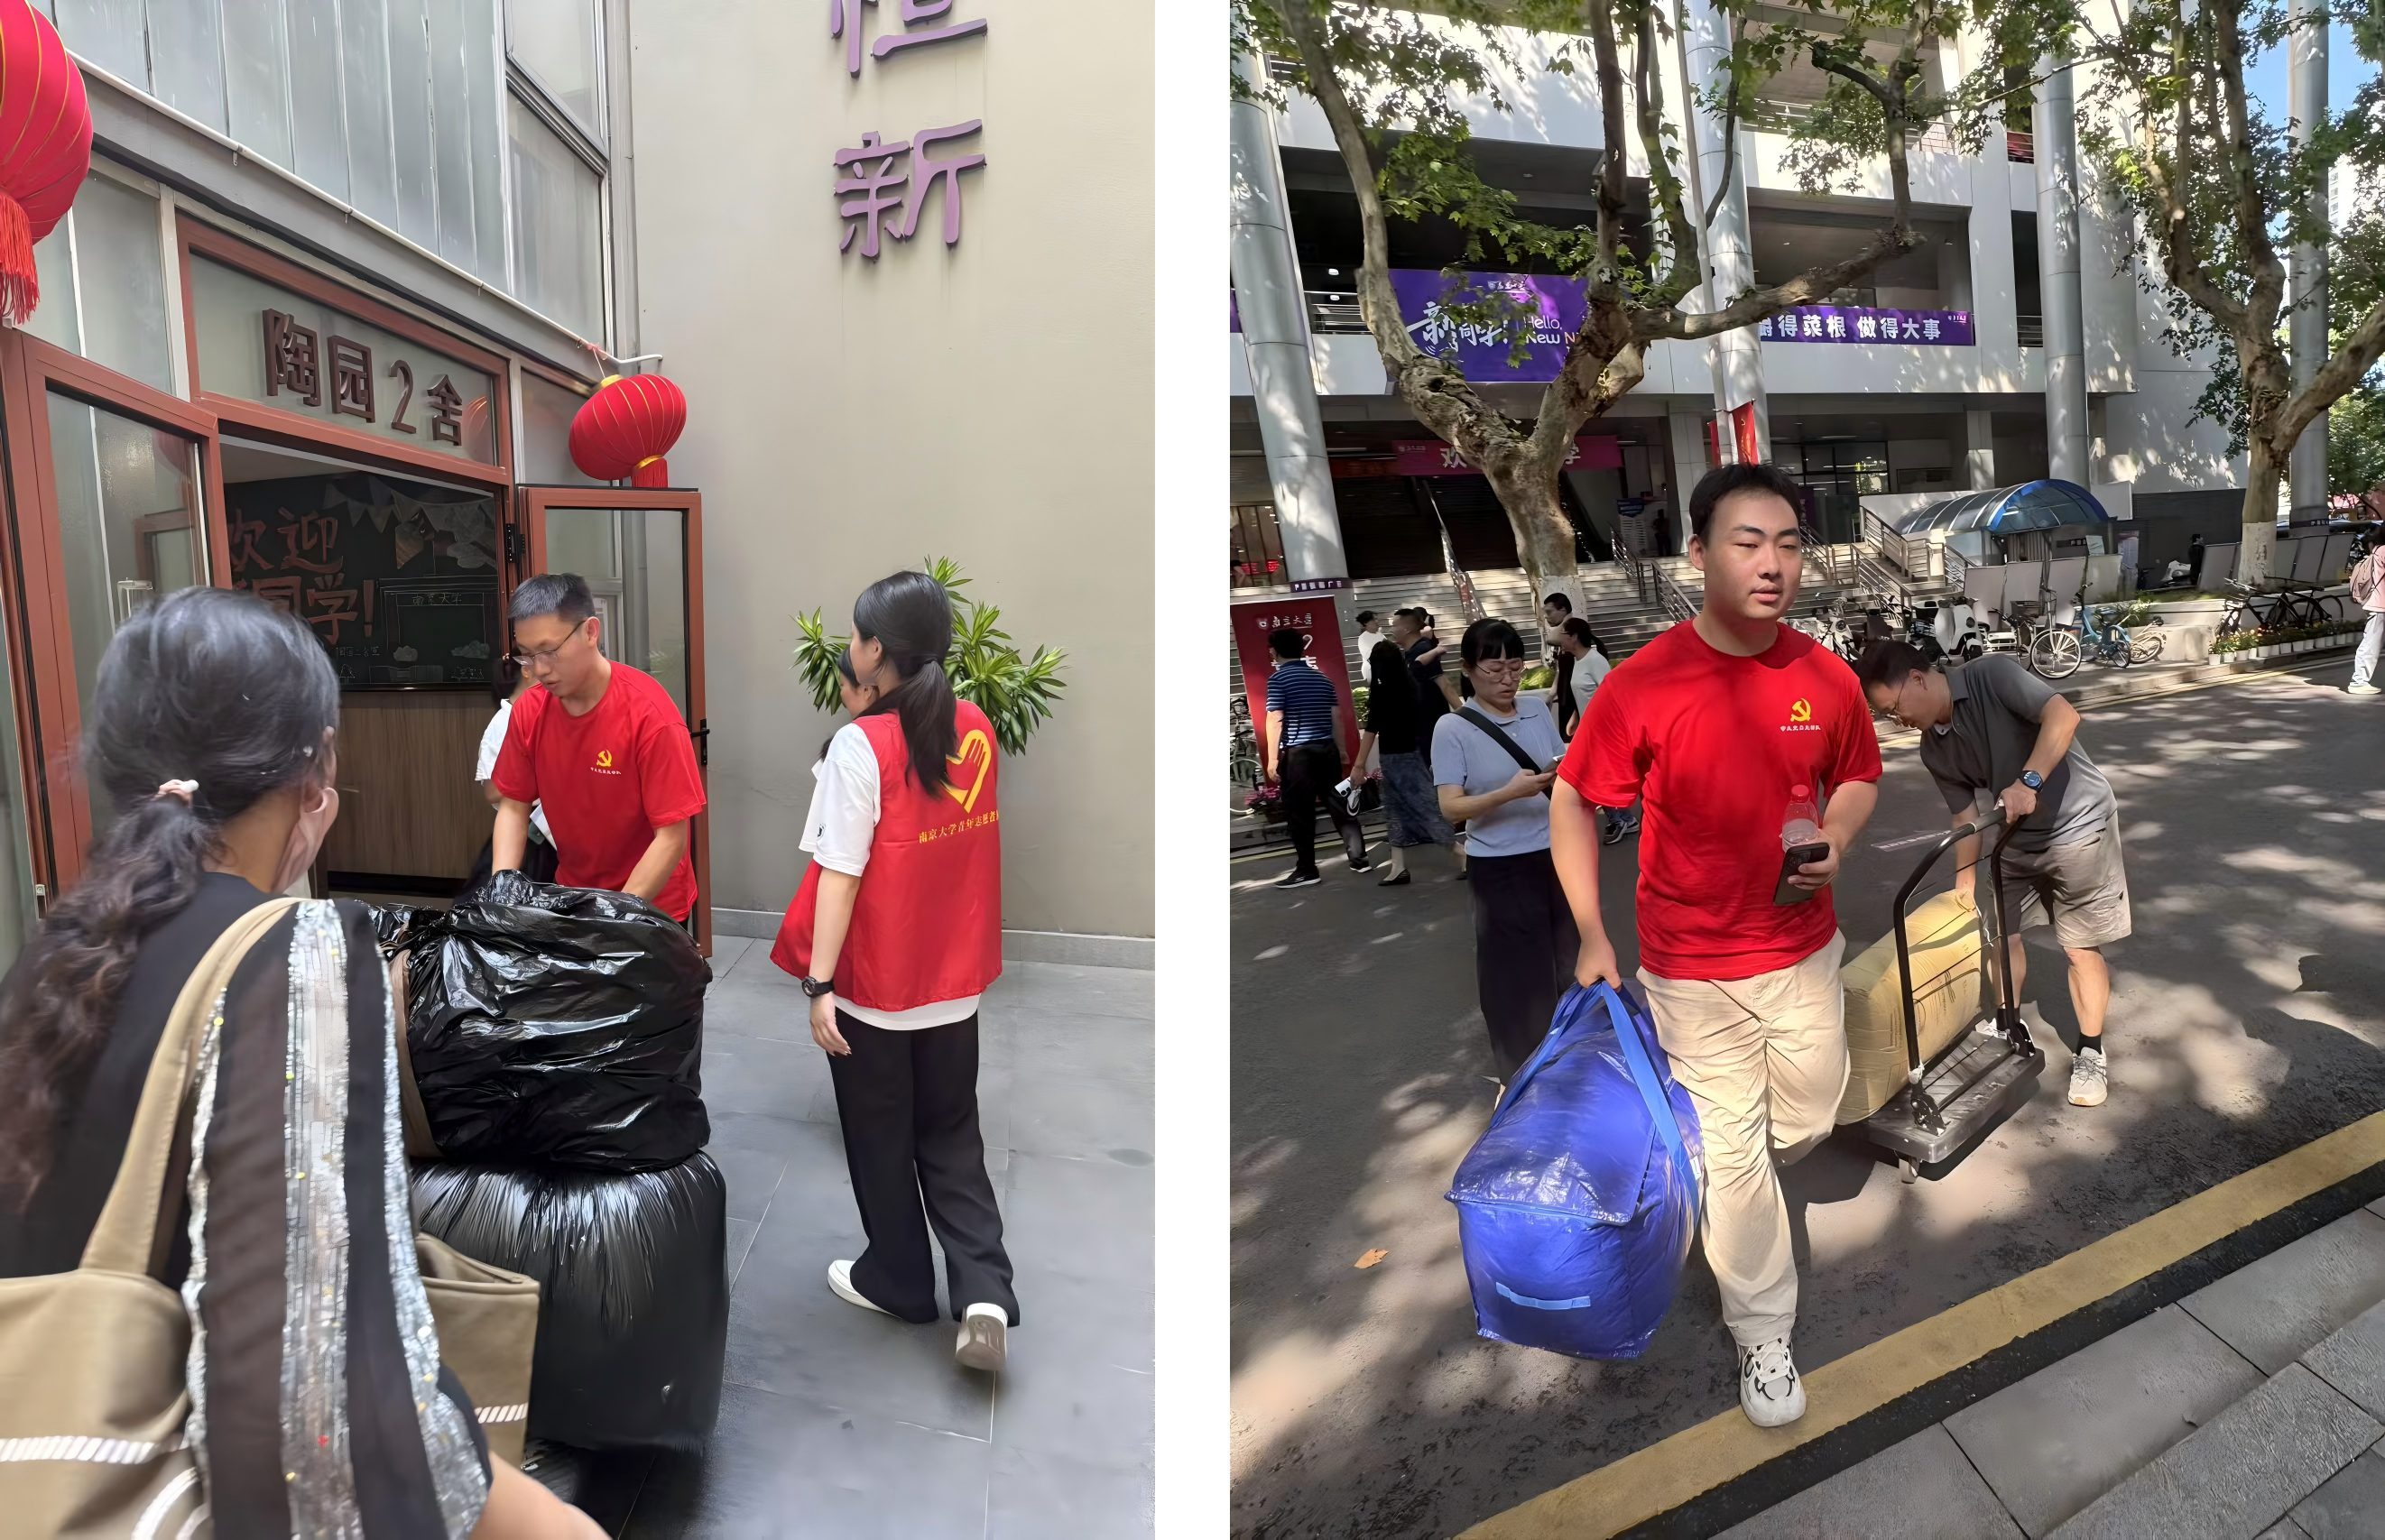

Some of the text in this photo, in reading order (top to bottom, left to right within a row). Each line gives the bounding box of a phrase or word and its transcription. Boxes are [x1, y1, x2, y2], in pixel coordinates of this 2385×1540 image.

[1526, 331, 1560, 344] New
[1857, 316, 1941, 340] 做得大事
[263, 309, 463, 446] 陶园2舍
[919, 810, 999, 844] 南京大学青年志愿者
